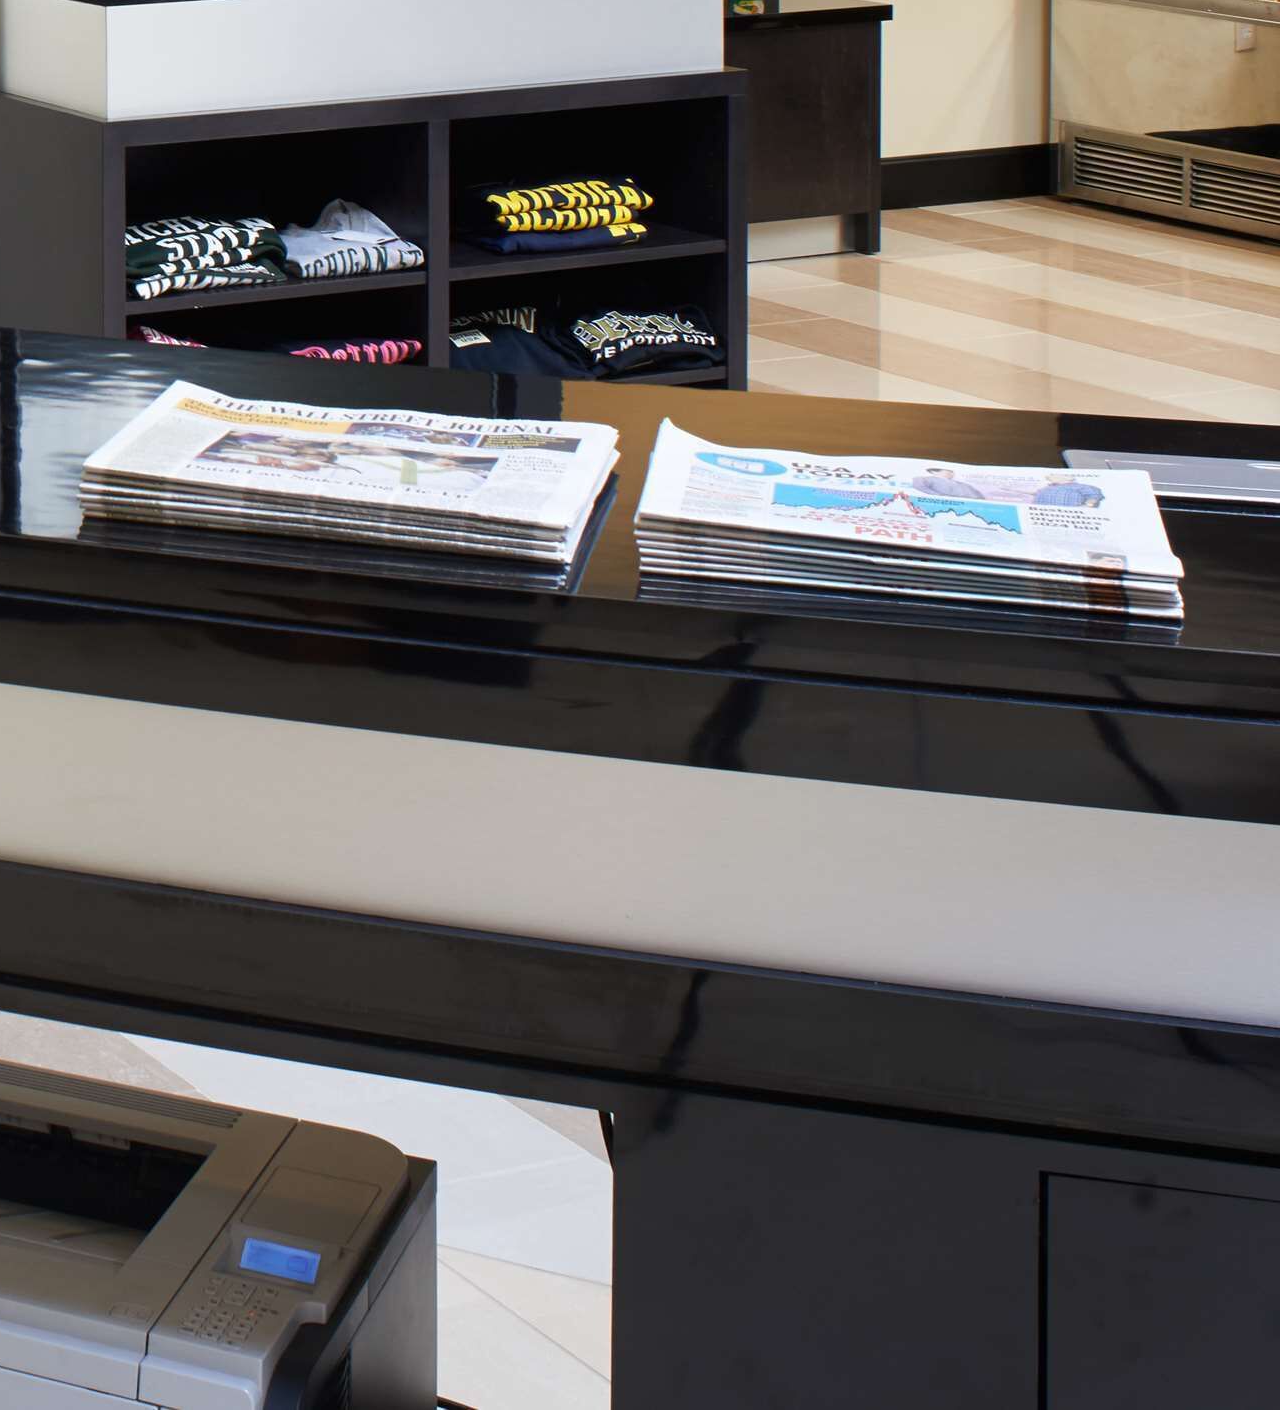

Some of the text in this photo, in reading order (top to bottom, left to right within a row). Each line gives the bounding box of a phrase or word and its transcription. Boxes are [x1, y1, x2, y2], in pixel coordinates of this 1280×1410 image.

[619, 334, 717, 352] MOTOR CITY
[212, 396, 265, 414] THE
[269, 404, 331, 422] WALL
[343, 411, 435, 430] STREET
[440, 420, 559, 437] JOURNAL
[791, 462, 853, 474] USA
[799, 470, 896, 480] TODAY
[1028, 506, 1085, 516] Boston
[1029, 512, 1111, 522] abandons
[1029, 516, 1103, 527] Olympics
[1073, 524, 1100, 532] bid
[855, 525, 934, 543] PATH
